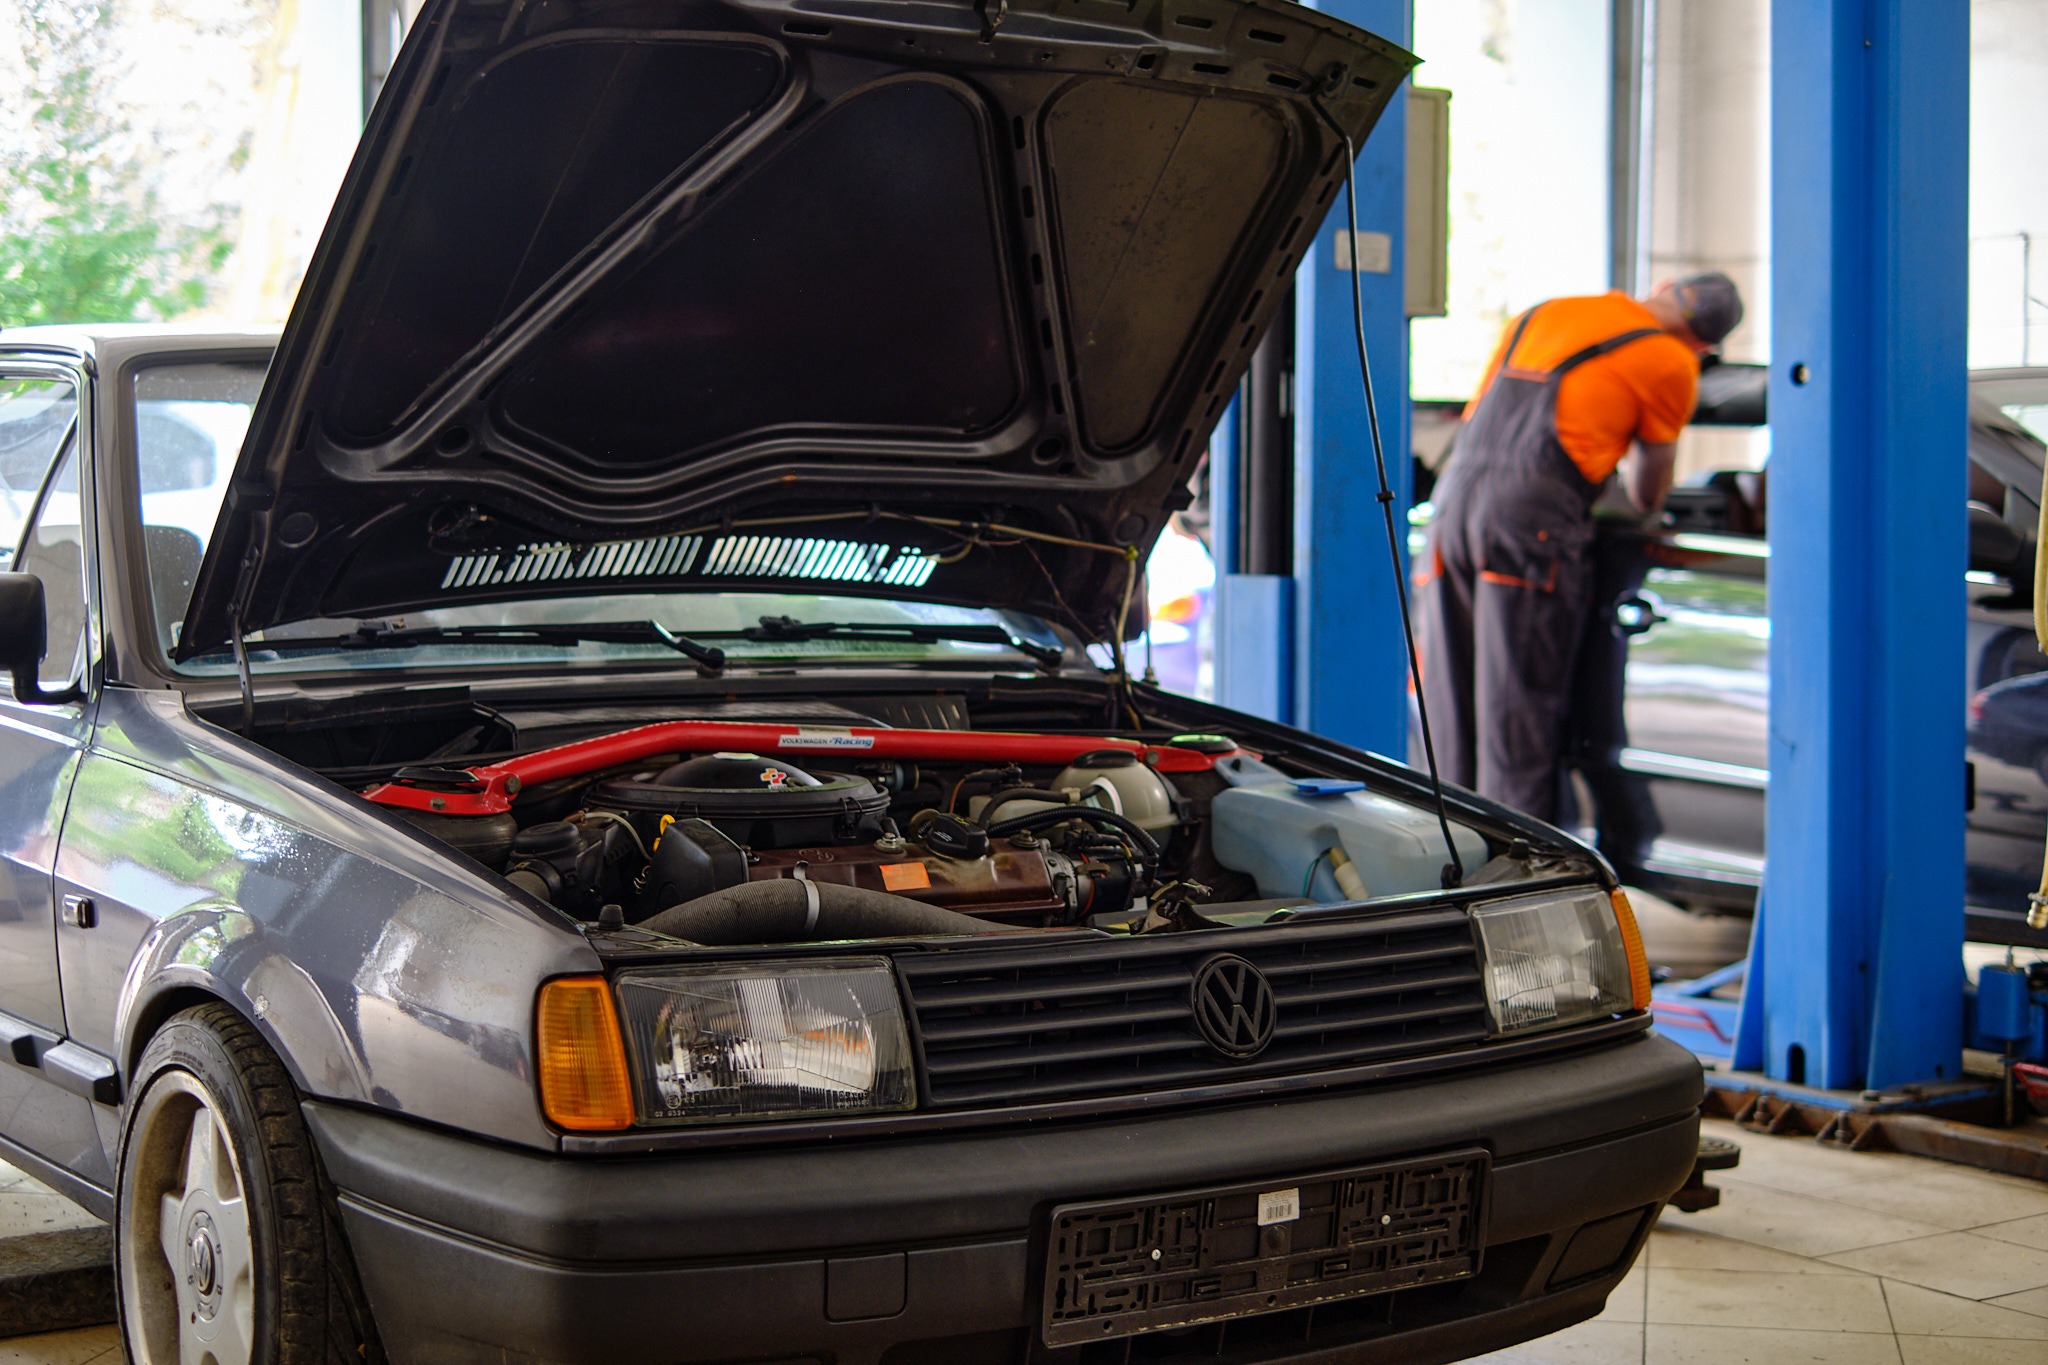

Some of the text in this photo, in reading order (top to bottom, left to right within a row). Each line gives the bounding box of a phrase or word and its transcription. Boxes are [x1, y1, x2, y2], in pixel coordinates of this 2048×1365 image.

[782, 737, 872, 747] VOLKSWAGEN Racing
[1198, 959, 1274, 1051] VW
